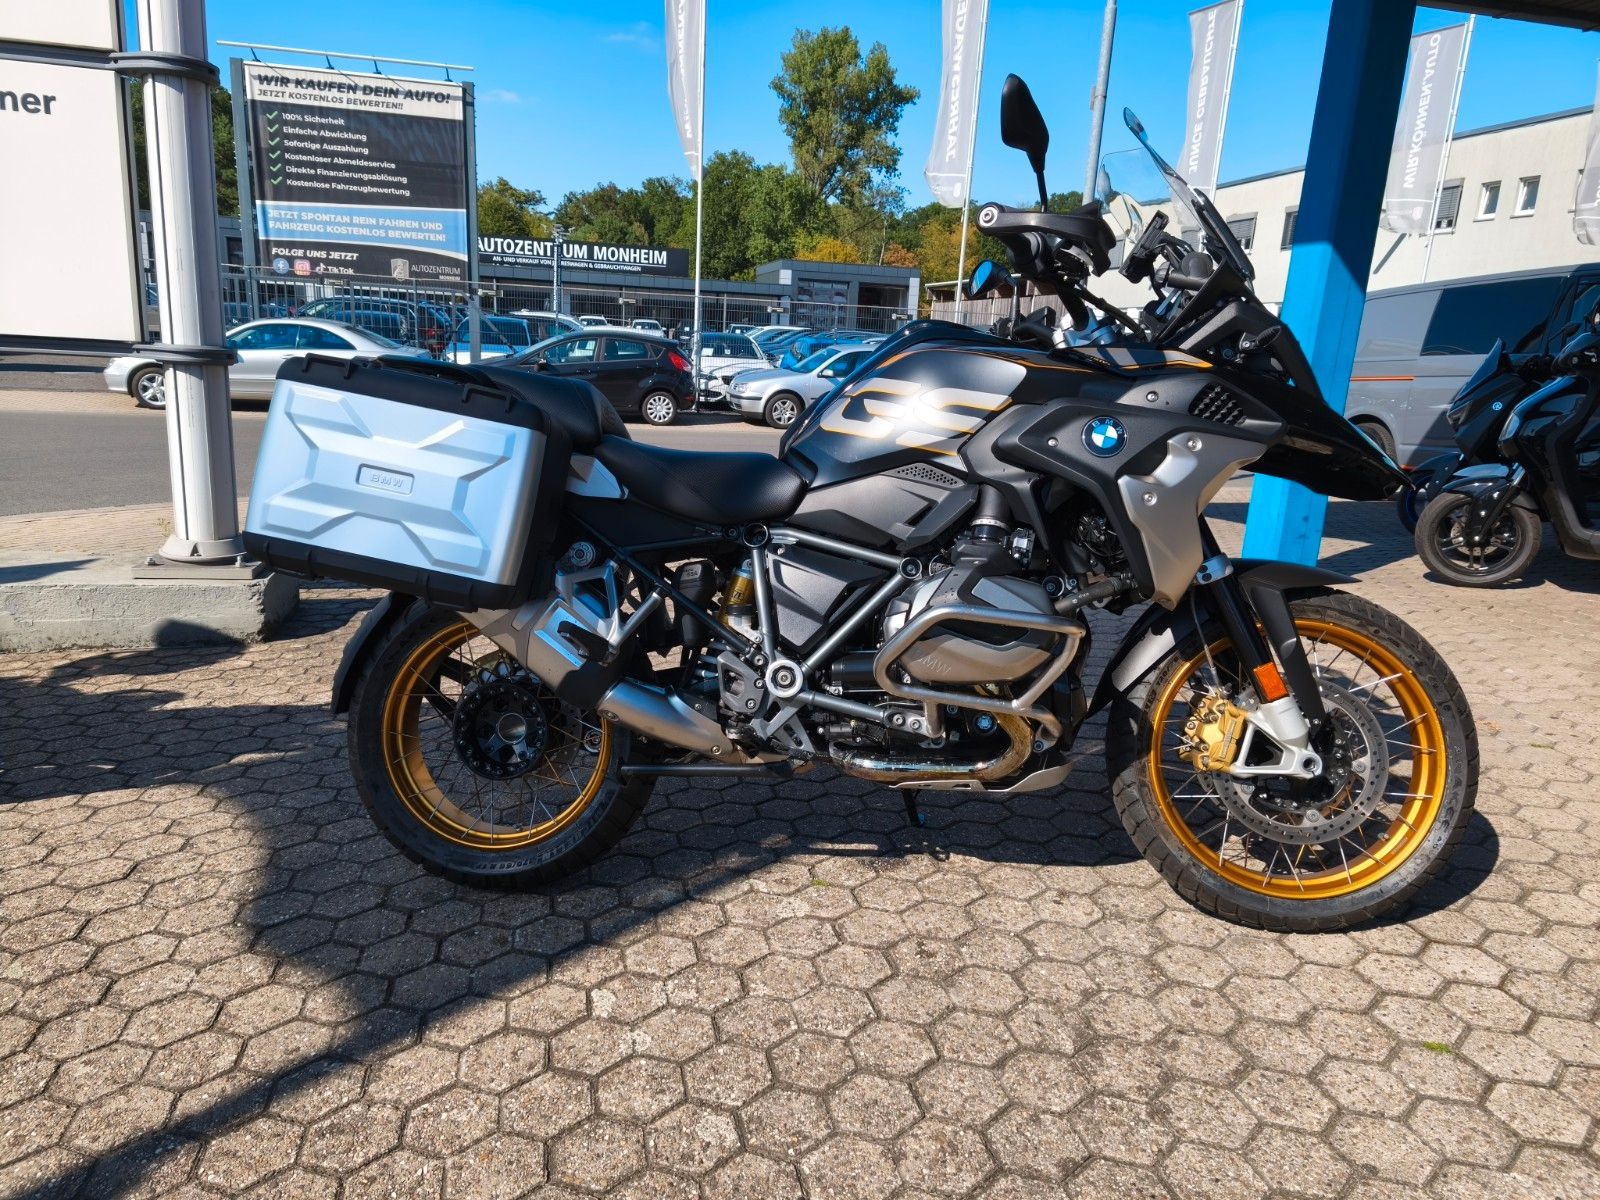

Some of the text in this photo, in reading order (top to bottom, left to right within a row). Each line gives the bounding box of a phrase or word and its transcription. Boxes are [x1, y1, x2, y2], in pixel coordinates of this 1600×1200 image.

[257, 74, 450, 104] WIR KAUFEN DEIN AUTO!
[257, 89, 403, 110] JETZT KOSTENLOS BEWERTEN!!
[282, 113, 345, 125] 100% Sicherheit
[283, 126, 367, 141] Einfache Abwicklung
[284, 140, 369, 155] Sofortige Auszahlung
[285, 153, 396, 169] Kostenloser Abmeldeservice
[285, 165, 407, 183] Direkte Finanzierungsablösung
[287, 179, 411, 197] Kostenlose Fahrzeugbewertung
[268, 209, 443, 231] JETZT SPONTAN REIN FAHREN UND
[269, 221, 446, 242] FAHRZEUG KOSTENLOS BEWERTEN!
[271, 247, 359, 260] FOLGE UNS JETZT
[478, 237, 667, 265] AUTOZENTUM MONHEIM
[411, 264, 460, 275] AUTOZENTRUM
[552, 260, 588, 268] JRESWAGEN
[594, 263, 642, 271] GEBRAUCHTWAGEN
[1091, 418, 1123, 435] BMW
